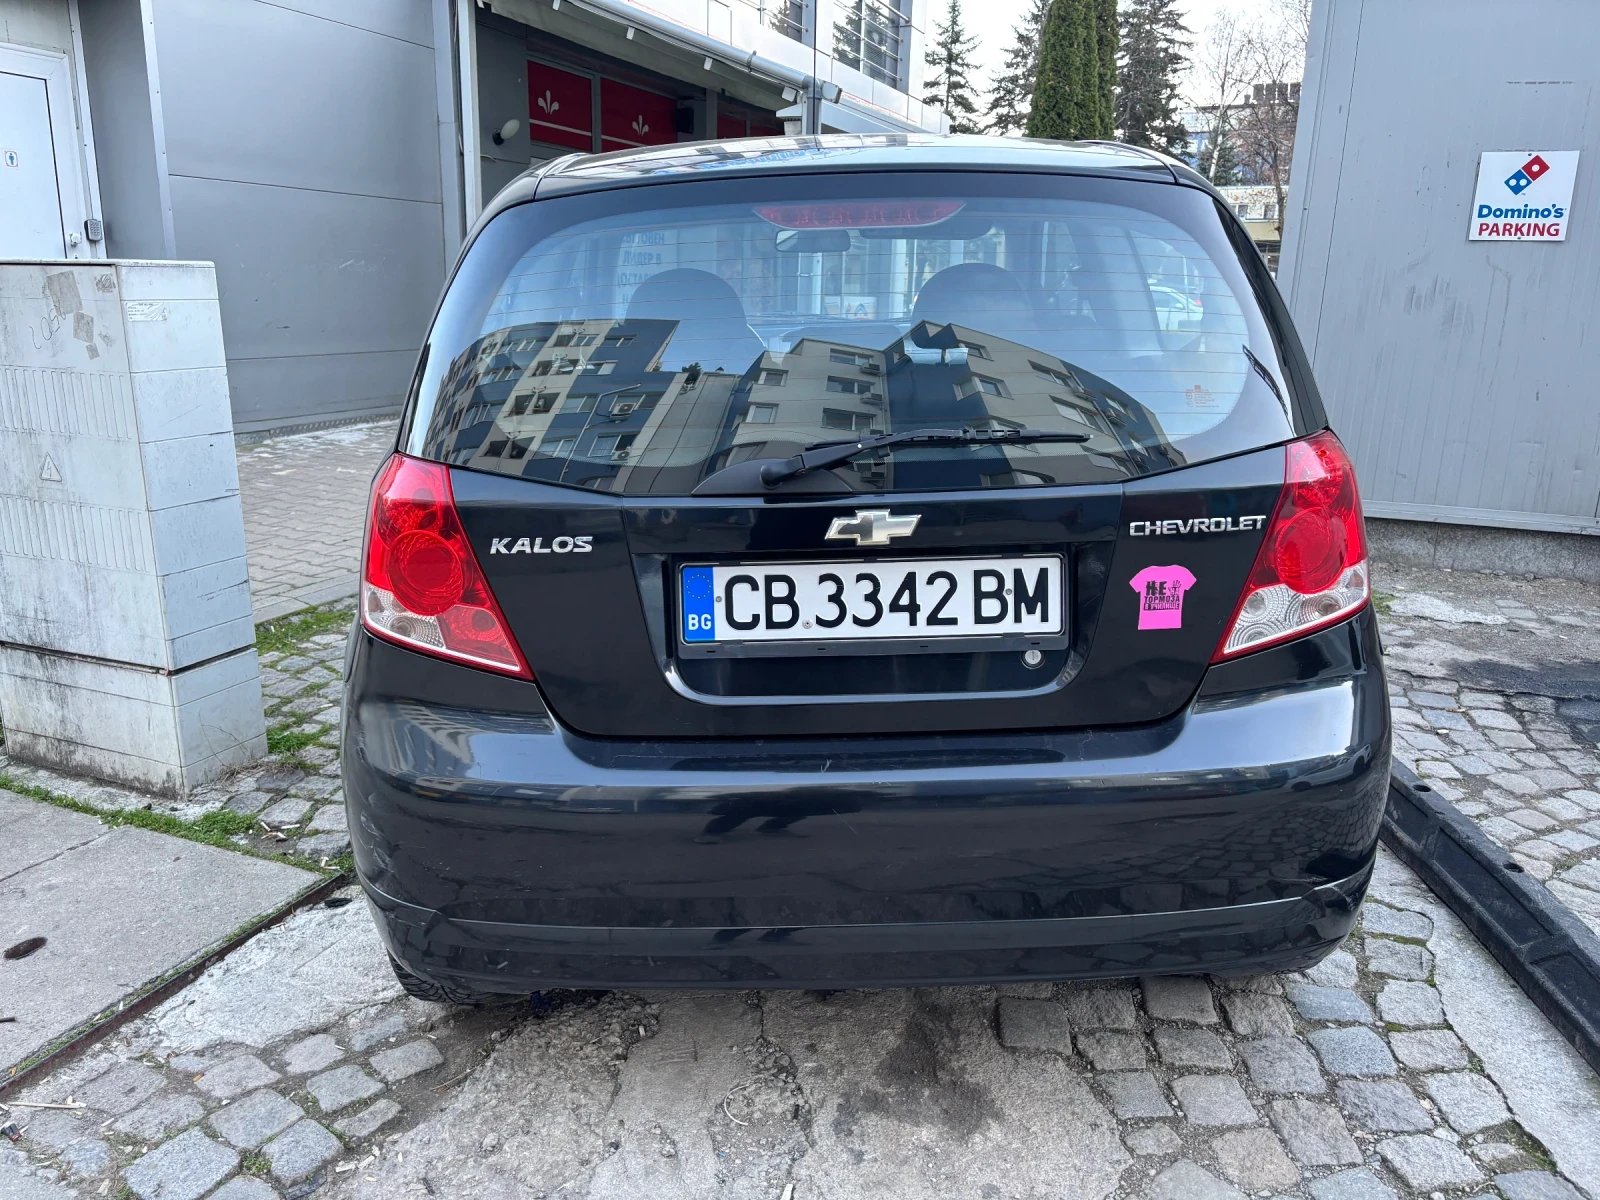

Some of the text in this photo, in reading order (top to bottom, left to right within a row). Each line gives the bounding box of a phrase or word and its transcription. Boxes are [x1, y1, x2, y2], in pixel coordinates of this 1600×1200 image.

[1477, 203, 1564, 219] Domino's
[1478, 223, 1560, 237] PARKING
[1129, 515, 1266, 536] CHEVROLET
[489, 536, 593, 554] KALOS
[1146, 581, 1168, 596] НЕ
[724, 567, 1049, 631] CB 3342 BM
[1144, 595, 1180, 603] ТОРМОЗА
[688, 614, 711, 630] BG
